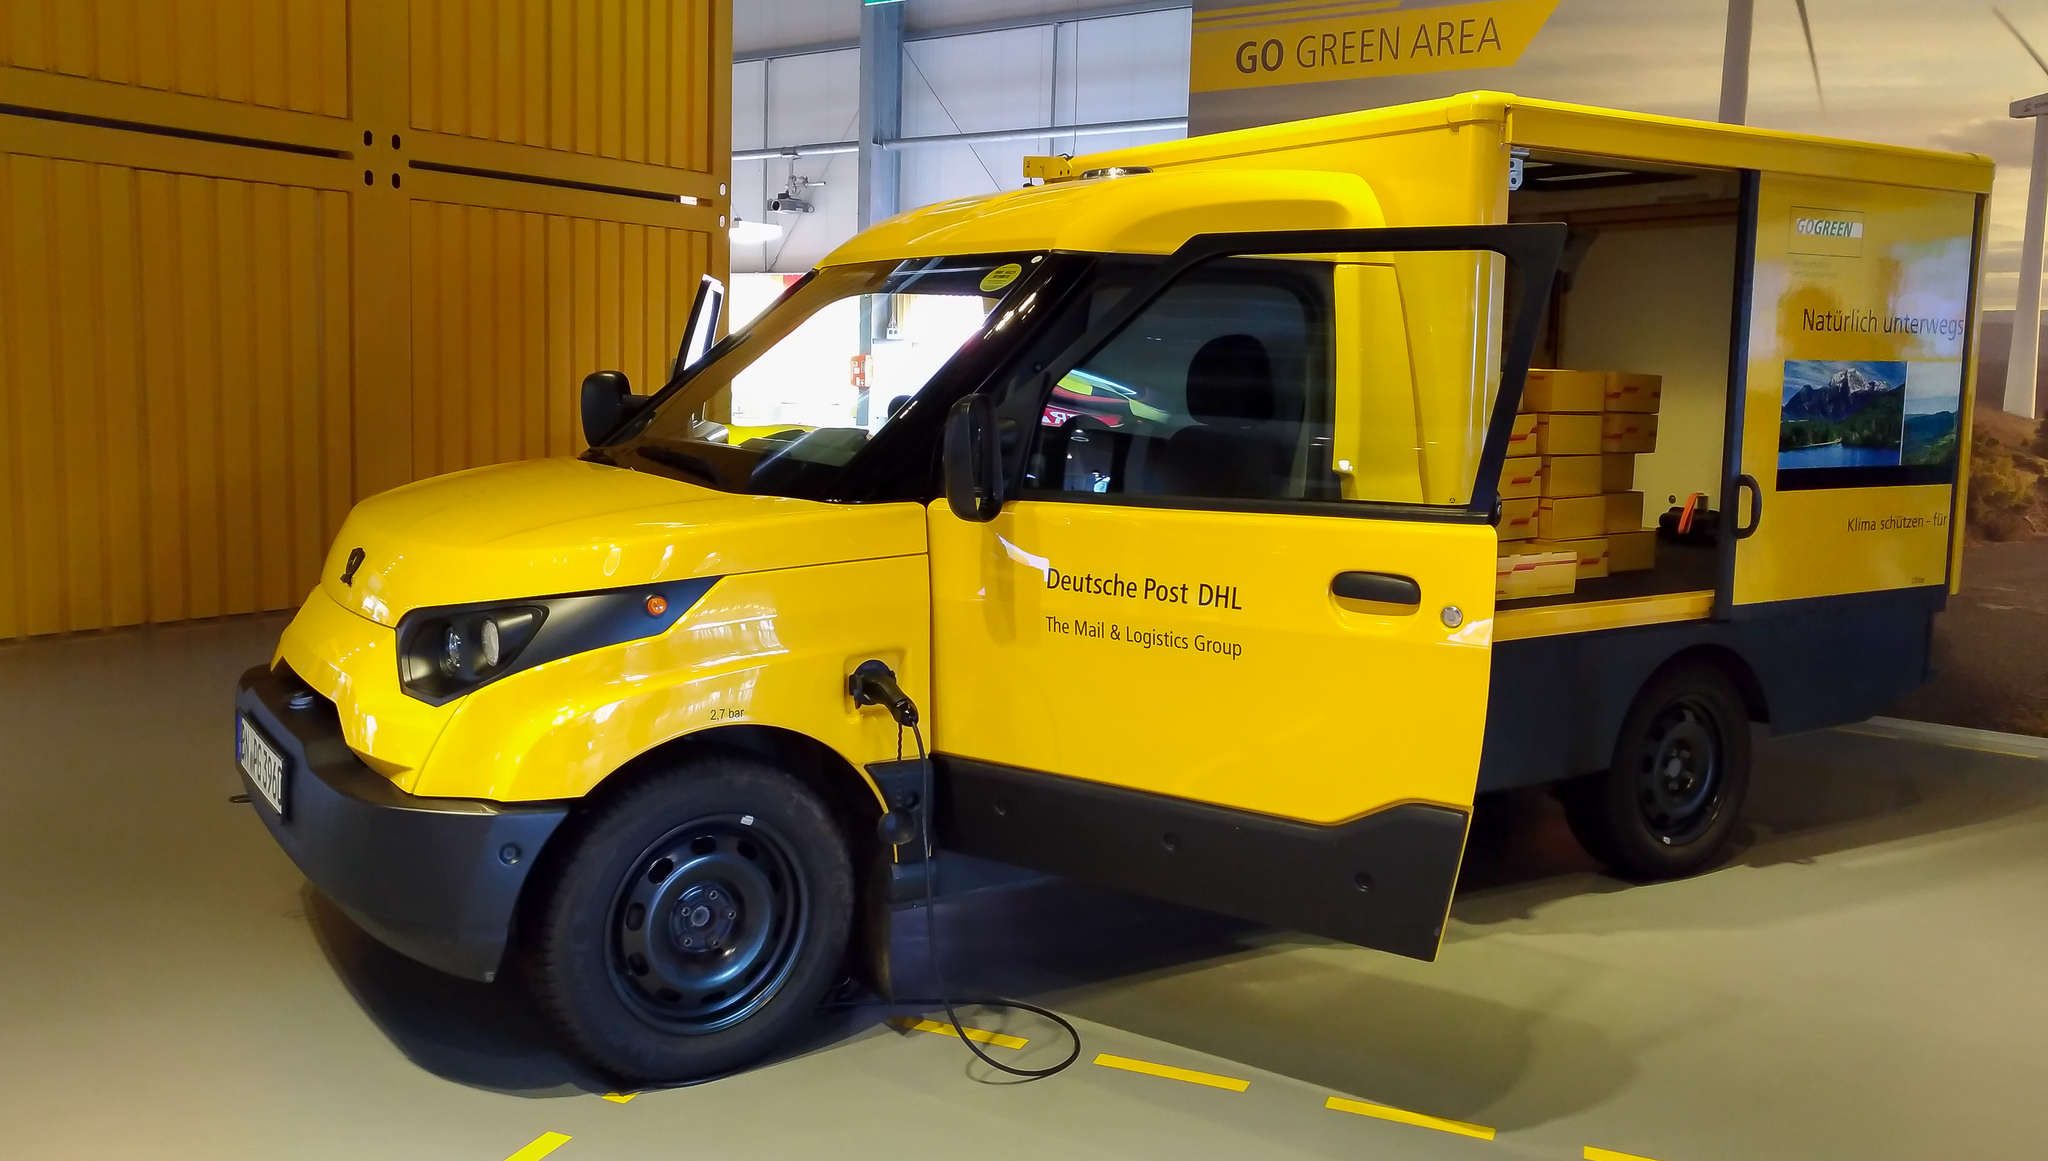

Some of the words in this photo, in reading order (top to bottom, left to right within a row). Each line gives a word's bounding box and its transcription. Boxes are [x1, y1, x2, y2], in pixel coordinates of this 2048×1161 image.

[1236, 38, 1284, 74] GO
[1296, 26, 1400, 68] GREEN
[1410, 16, 1502, 59] AREA
[1797, 218, 1853, 237] GOGREEN
[1802, 308, 1877, 333] Natürlich
[1883, 314, 1965, 341] unterwegs
[1847, 517, 1877, 532] Klima
[1880, 515, 1924, 530] schützen
[1933, 512, 1948, 527] für
[1046, 567, 1138, 598] Deutsche
[1144, 577, 1189, 604] Post
[1198, 583, 1242, 610] DHL
[1045, 615, 1070, 634] The
[1074, 619, 1105, 639] Mail
[1110, 624, 1121, 641] &
[1126, 625, 1189, 649] Logistics
[1194, 634, 1242, 660] Group
[728, 707, 744, 719] bar
